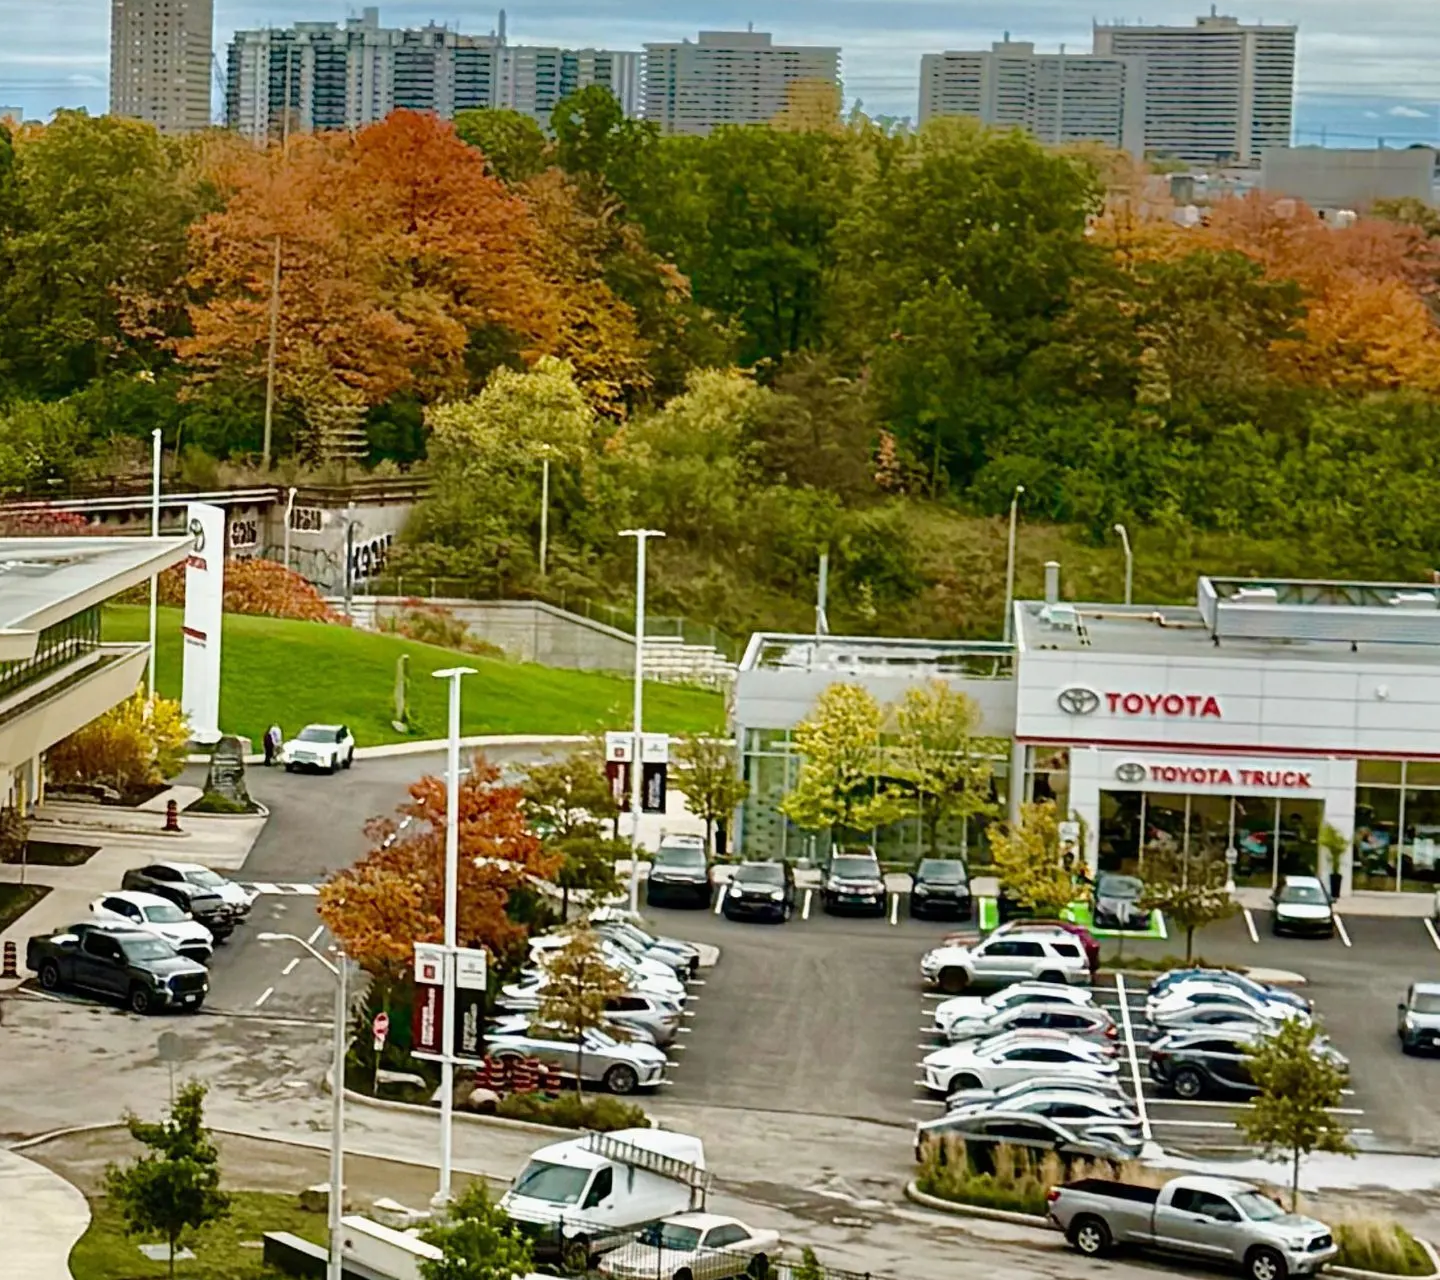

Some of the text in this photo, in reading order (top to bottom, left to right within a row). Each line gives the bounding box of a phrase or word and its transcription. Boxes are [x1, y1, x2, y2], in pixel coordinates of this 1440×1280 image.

[1105, 692, 1222, 718] TOYOTA
[1149, 766, 1312, 788] TOYOTA TRUCK
